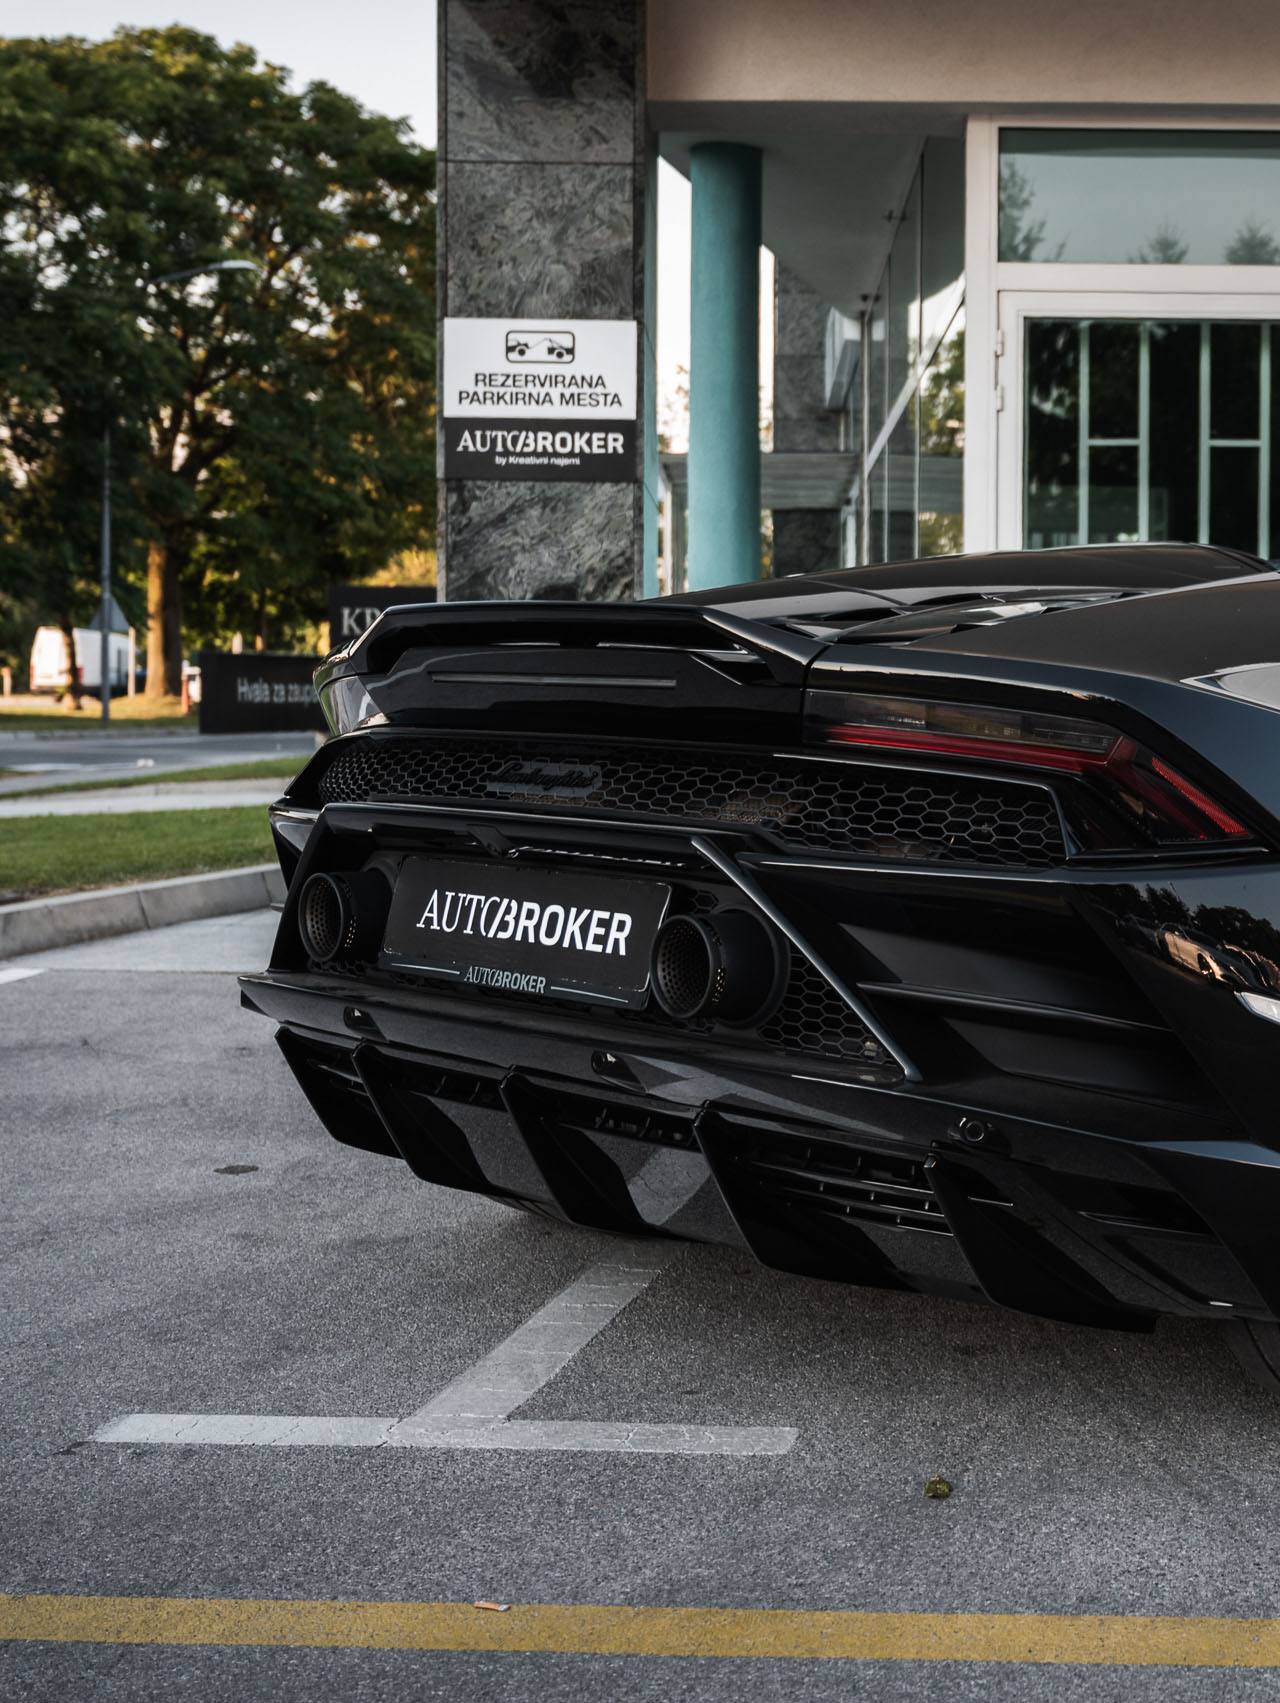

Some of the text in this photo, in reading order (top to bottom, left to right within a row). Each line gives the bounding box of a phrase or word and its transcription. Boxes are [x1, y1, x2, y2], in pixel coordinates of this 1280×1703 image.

[474, 373, 607, 389] REZERVIRANA
[458, 390, 623, 408] PARKIRNA MESTA
[456, 429, 624, 454] AUTOBROKER
[495, 455, 507, 466] by
[416, 889, 632, 956] AUTOBROKER
[463, 965, 546, 994] AUTOBROKER
